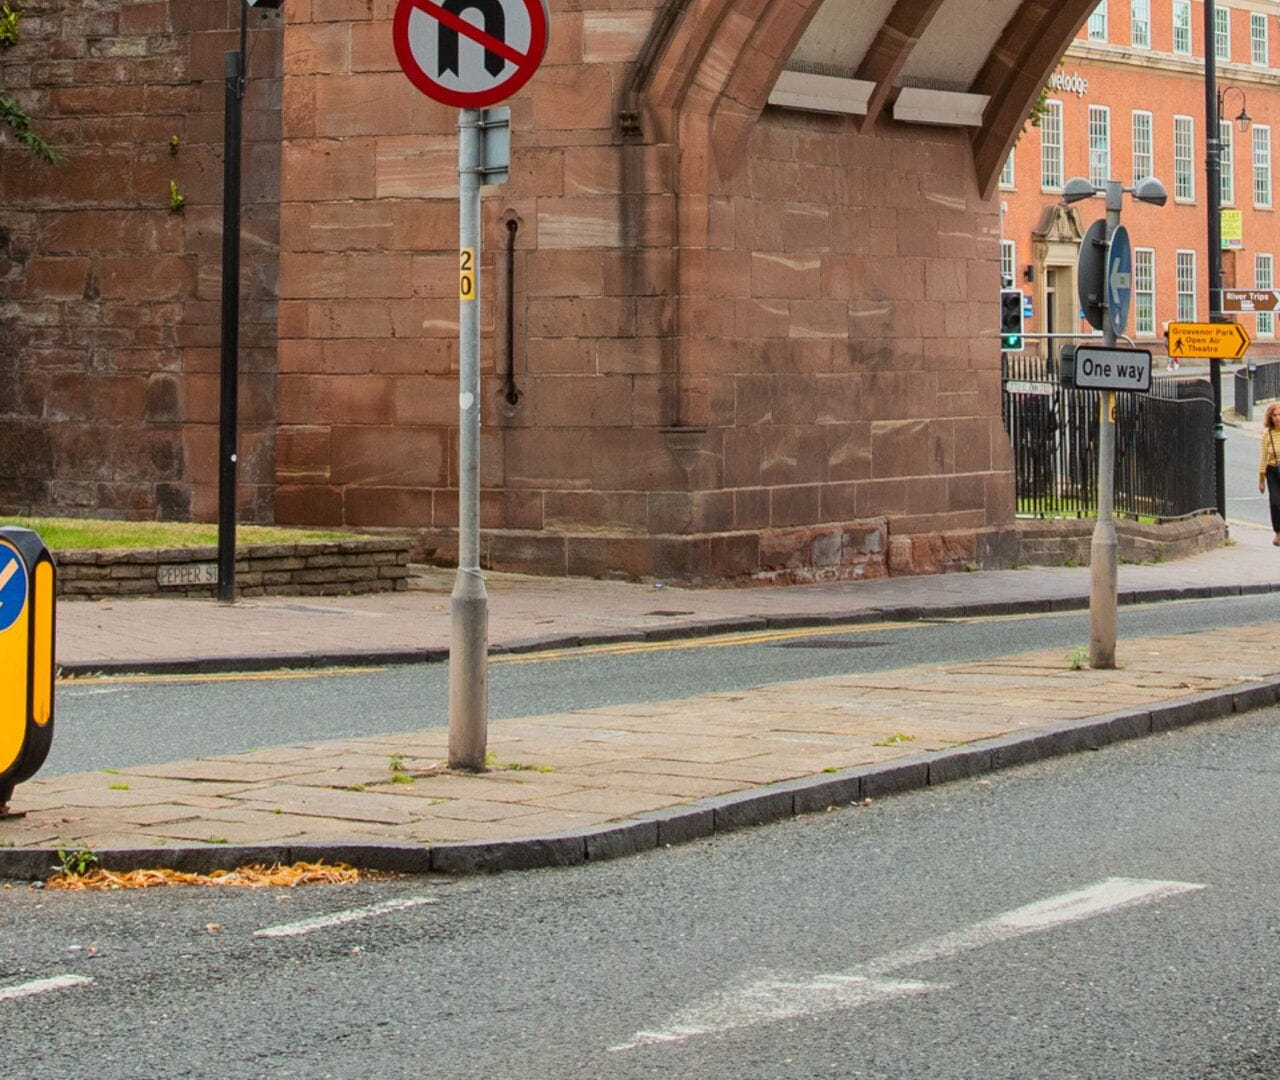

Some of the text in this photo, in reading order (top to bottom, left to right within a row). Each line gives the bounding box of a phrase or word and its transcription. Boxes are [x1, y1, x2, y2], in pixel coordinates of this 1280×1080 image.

[1048, 70, 1088, 98] velodge
[1226, 292, 1269, 301] River Trips
[1186, 337, 1207, 345] Open
[1188, 344, 1218, 352] Theatre
[1082, 358, 1145, 382] One way
[160, 567, 201, 583] PEPPER
